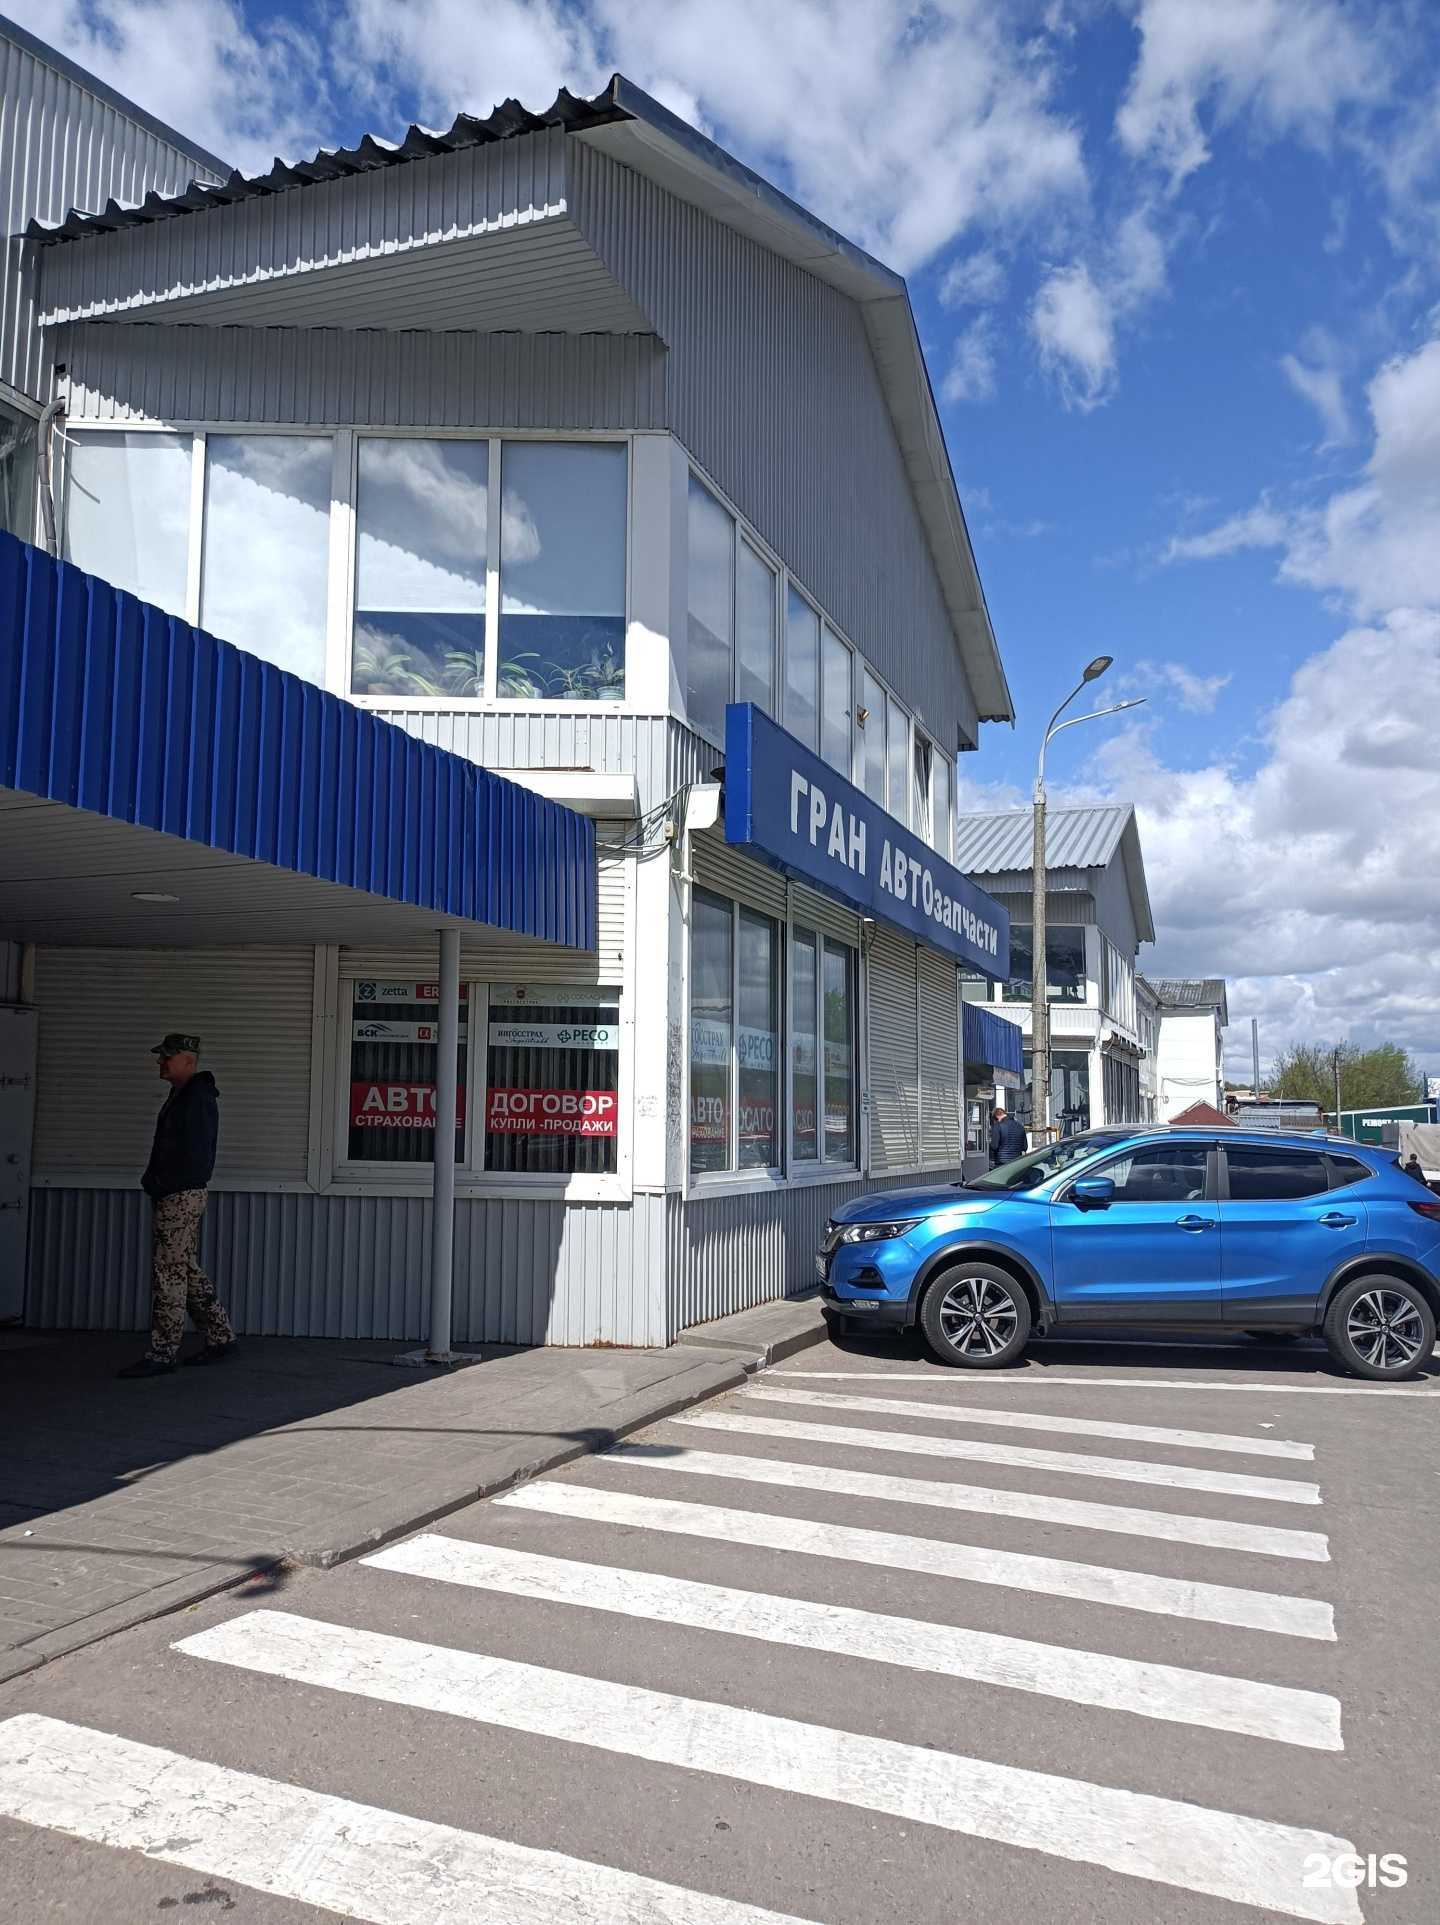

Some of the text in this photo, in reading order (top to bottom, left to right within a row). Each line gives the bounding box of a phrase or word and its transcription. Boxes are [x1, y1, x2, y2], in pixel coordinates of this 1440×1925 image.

[790, 769, 998, 957] ГРАН АВТОзапчасти
[382, 986, 409, 997] zetta
[573, 1029, 609, 1042] РЕСО
[748, 1034, 773, 1060] РЕСО
[362, 1086, 436, 1112] АВТ
[490, 1092, 613, 1116] ДОГОВОР
[355, 1115, 463, 1128] СТРАХОВАЕ
[490, 1117, 535, 1129] КУПЛИ
